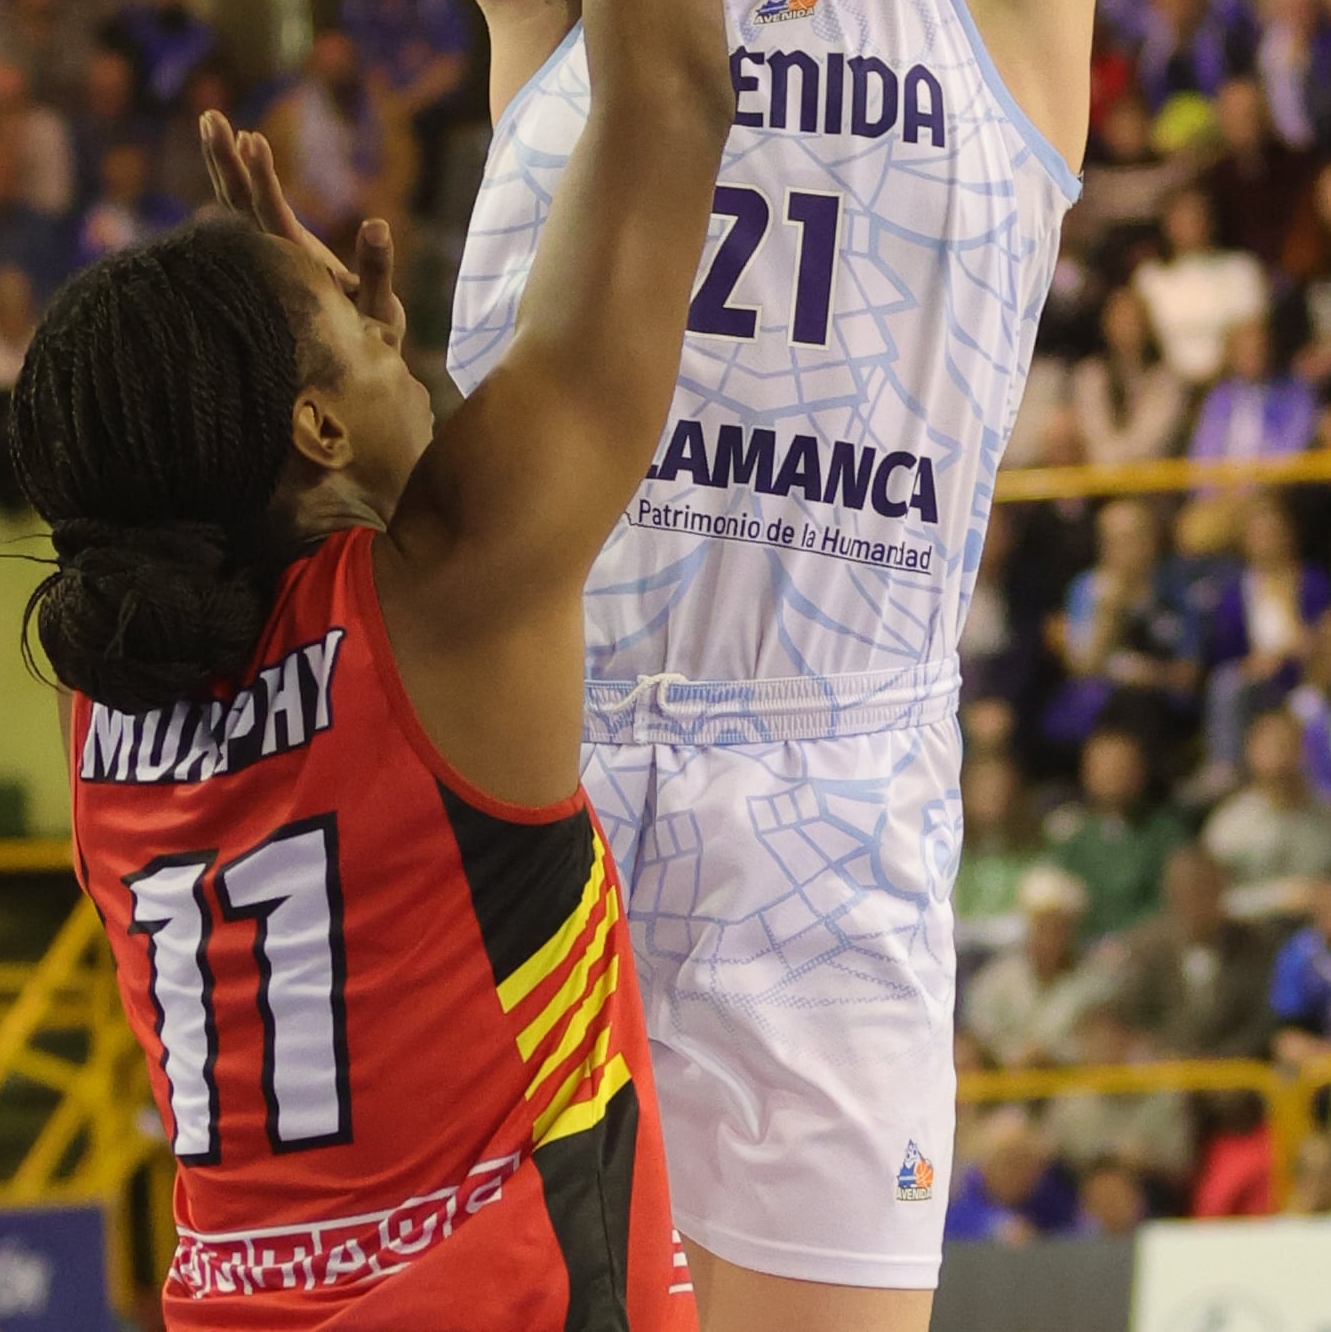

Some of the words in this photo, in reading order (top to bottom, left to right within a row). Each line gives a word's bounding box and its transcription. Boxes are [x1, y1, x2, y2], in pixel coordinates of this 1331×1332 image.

[753, 8, 815, 25] AVENIDA
[685, 181, 844, 350] 21
[638, 498, 761, 539] Patrimonio
[766, 517, 796, 544] de
[800, 522, 817, 549] la
[122, 812, 354, 1165] 11
